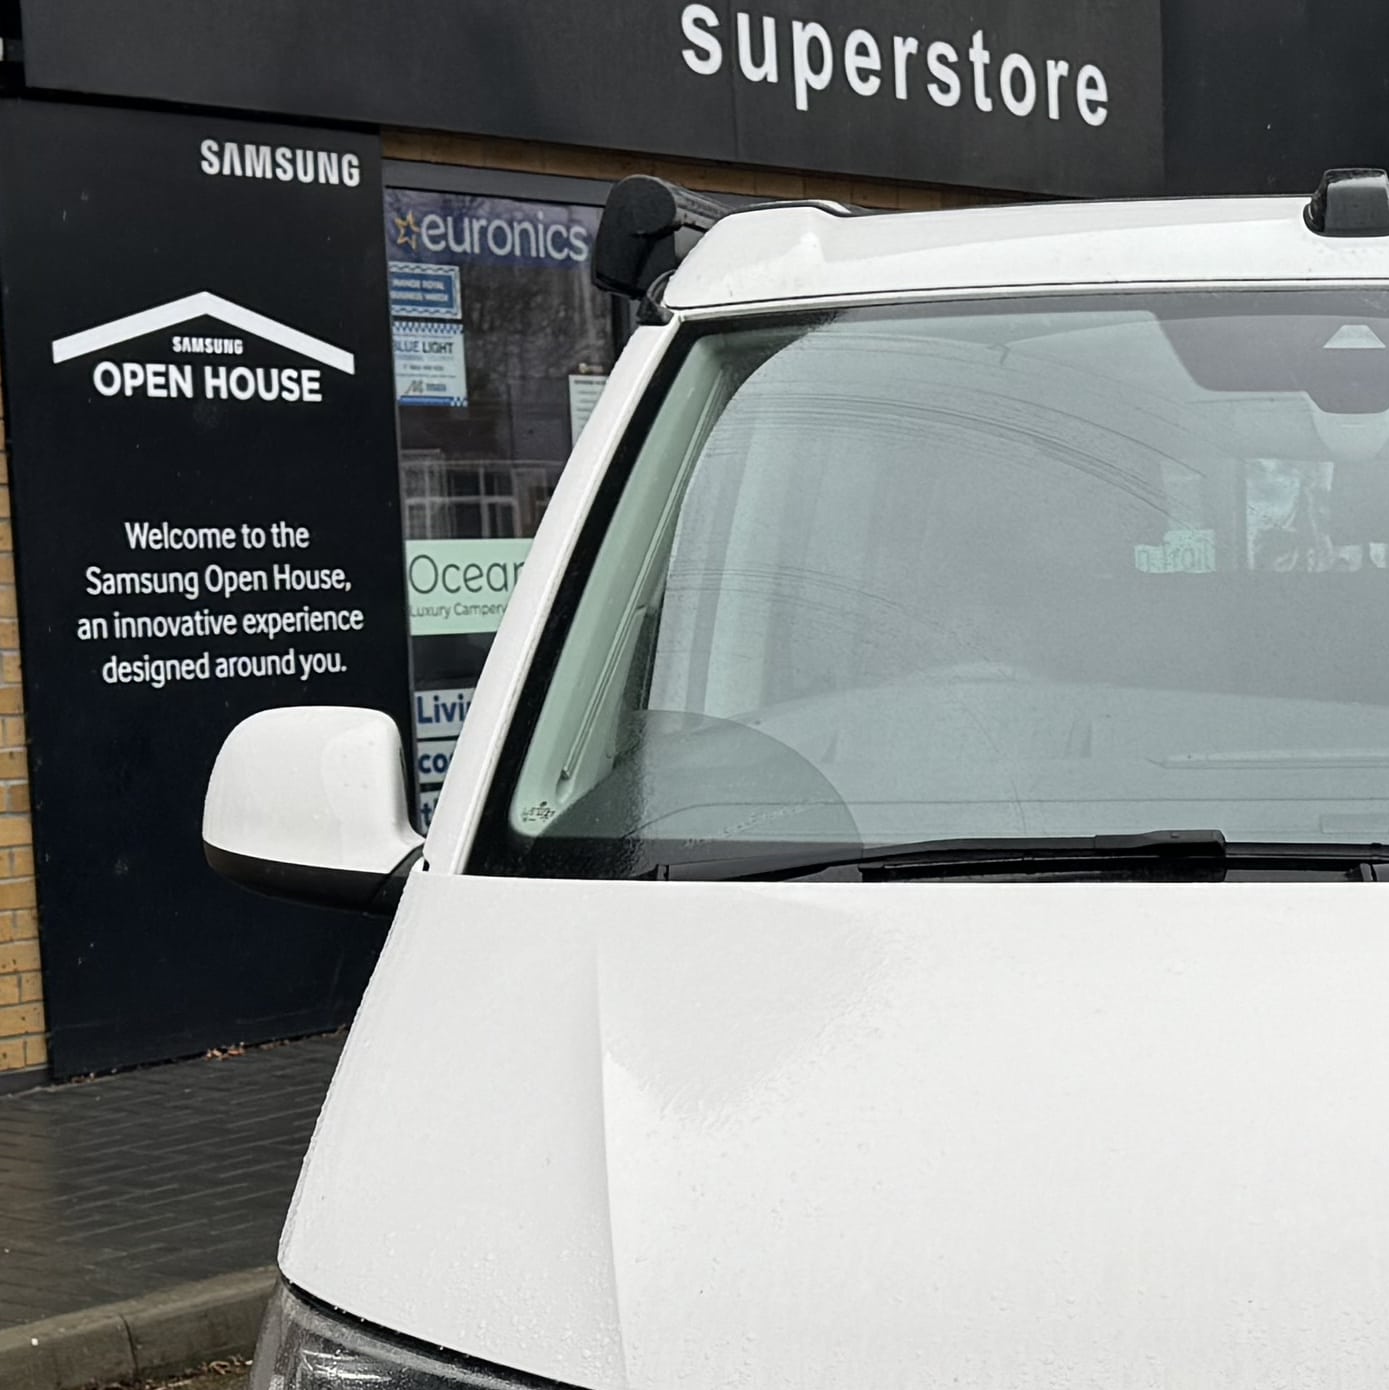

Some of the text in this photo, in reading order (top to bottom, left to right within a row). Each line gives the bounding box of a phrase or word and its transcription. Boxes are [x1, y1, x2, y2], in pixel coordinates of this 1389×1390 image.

[681, 3, 1108, 126] superstore
[200, 139, 360, 187] SAMSUNG
[421, 211, 588, 262] euronics
[172, 336, 243, 355] SAMSUNG
[422, 341, 454, 354] LIGHT
[93, 361, 322, 402] OPEN HOUSE
[124, 520, 310, 550] Welcome to the
[85, 563, 352, 600] Samsung Open House,
[77, 605, 364, 640] an innovative experience
[102, 648, 347, 689] designed around you.
[417, 752, 453, 774] co
